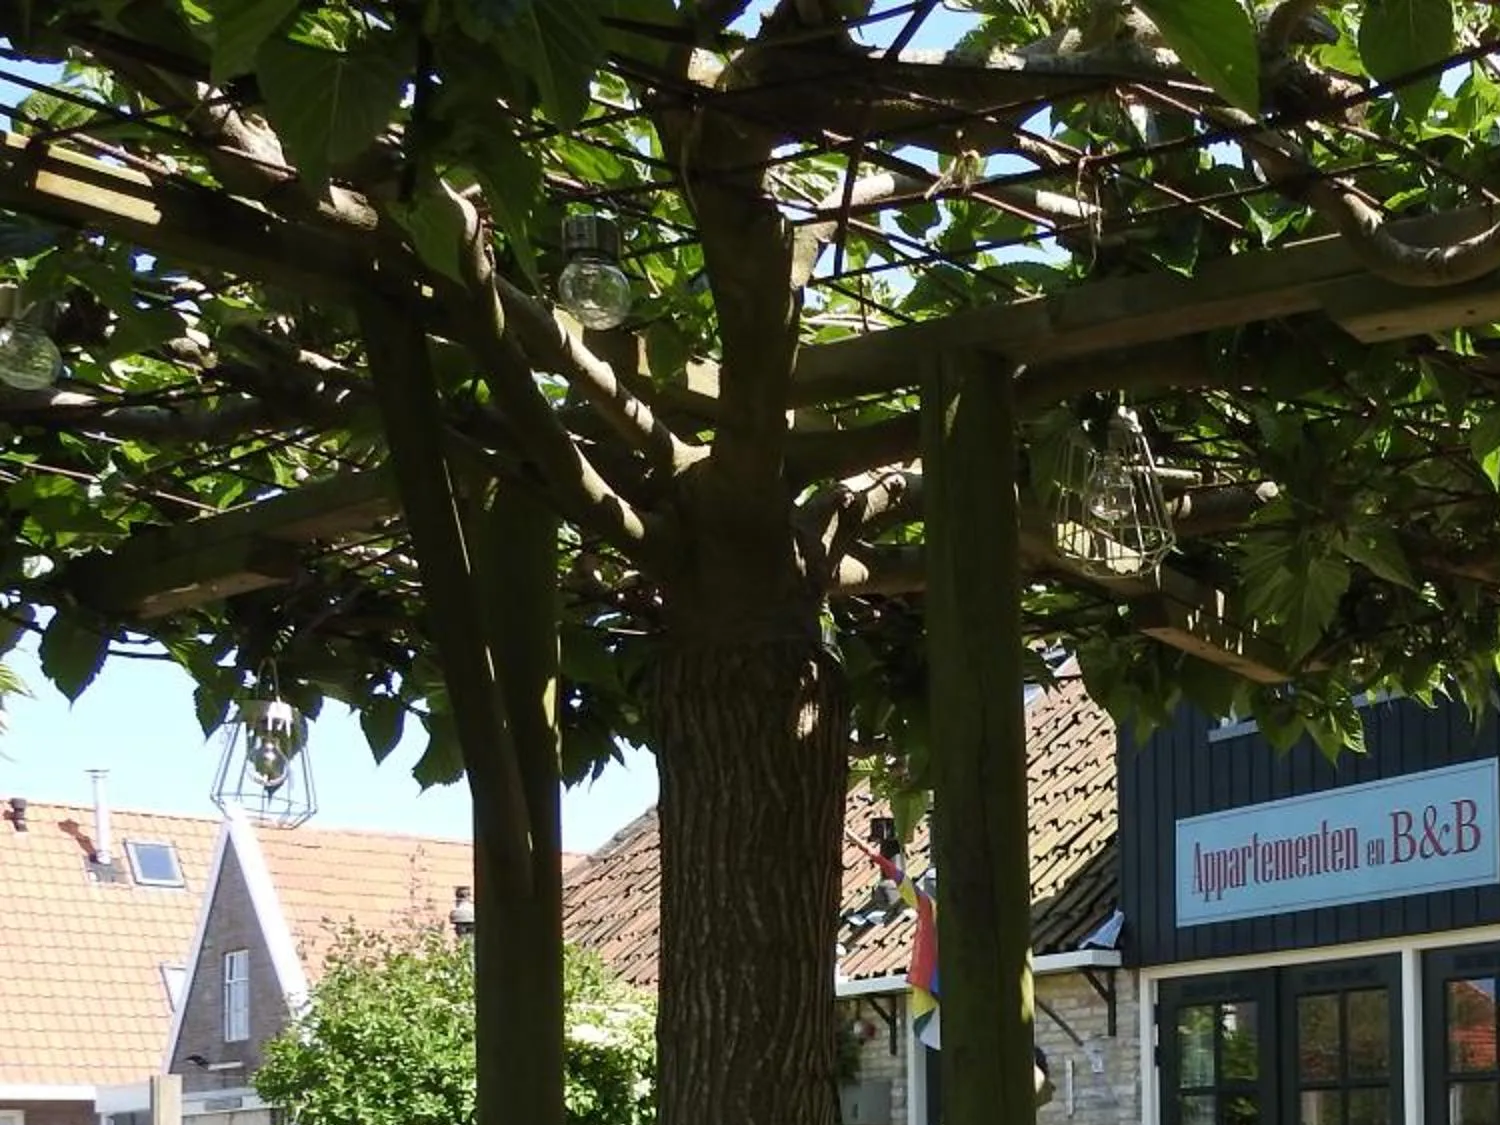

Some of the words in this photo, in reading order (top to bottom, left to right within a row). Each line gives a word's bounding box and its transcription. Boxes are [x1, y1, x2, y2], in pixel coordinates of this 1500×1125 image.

[1191, 820, 1359, 902] Appartementen
[1366, 836, 1386, 866] en
[1389, 798, 1482, 865] B&B
